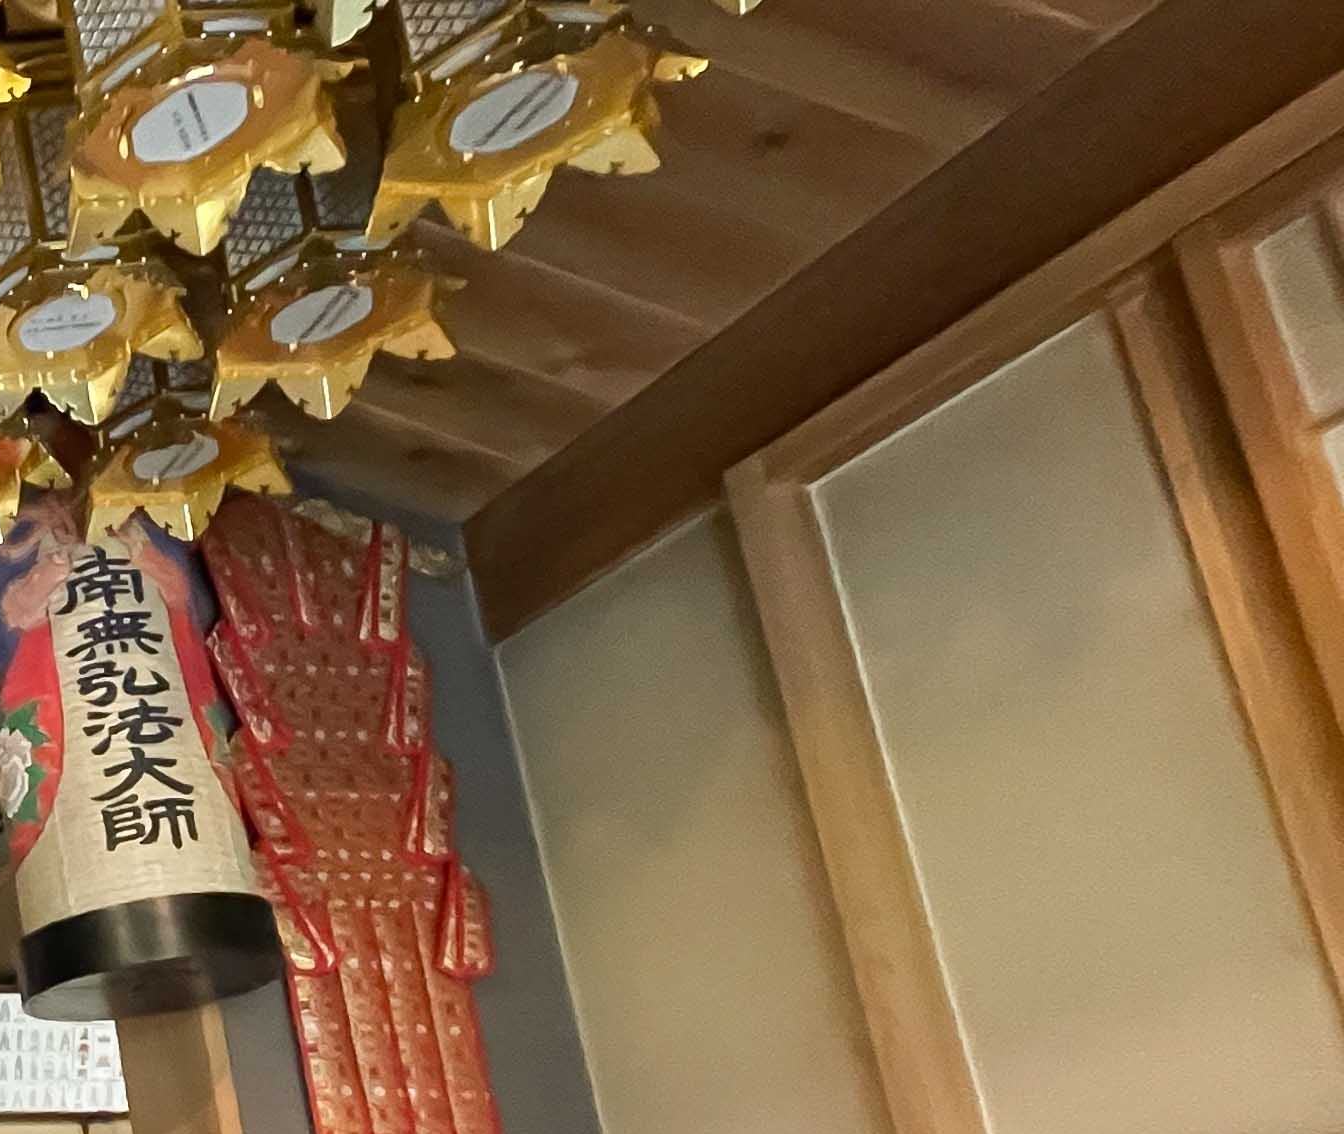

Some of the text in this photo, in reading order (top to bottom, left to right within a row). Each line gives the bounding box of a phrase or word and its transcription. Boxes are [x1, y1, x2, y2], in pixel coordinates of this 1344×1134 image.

[54, 545, 199, 852] 南無弘法大師
